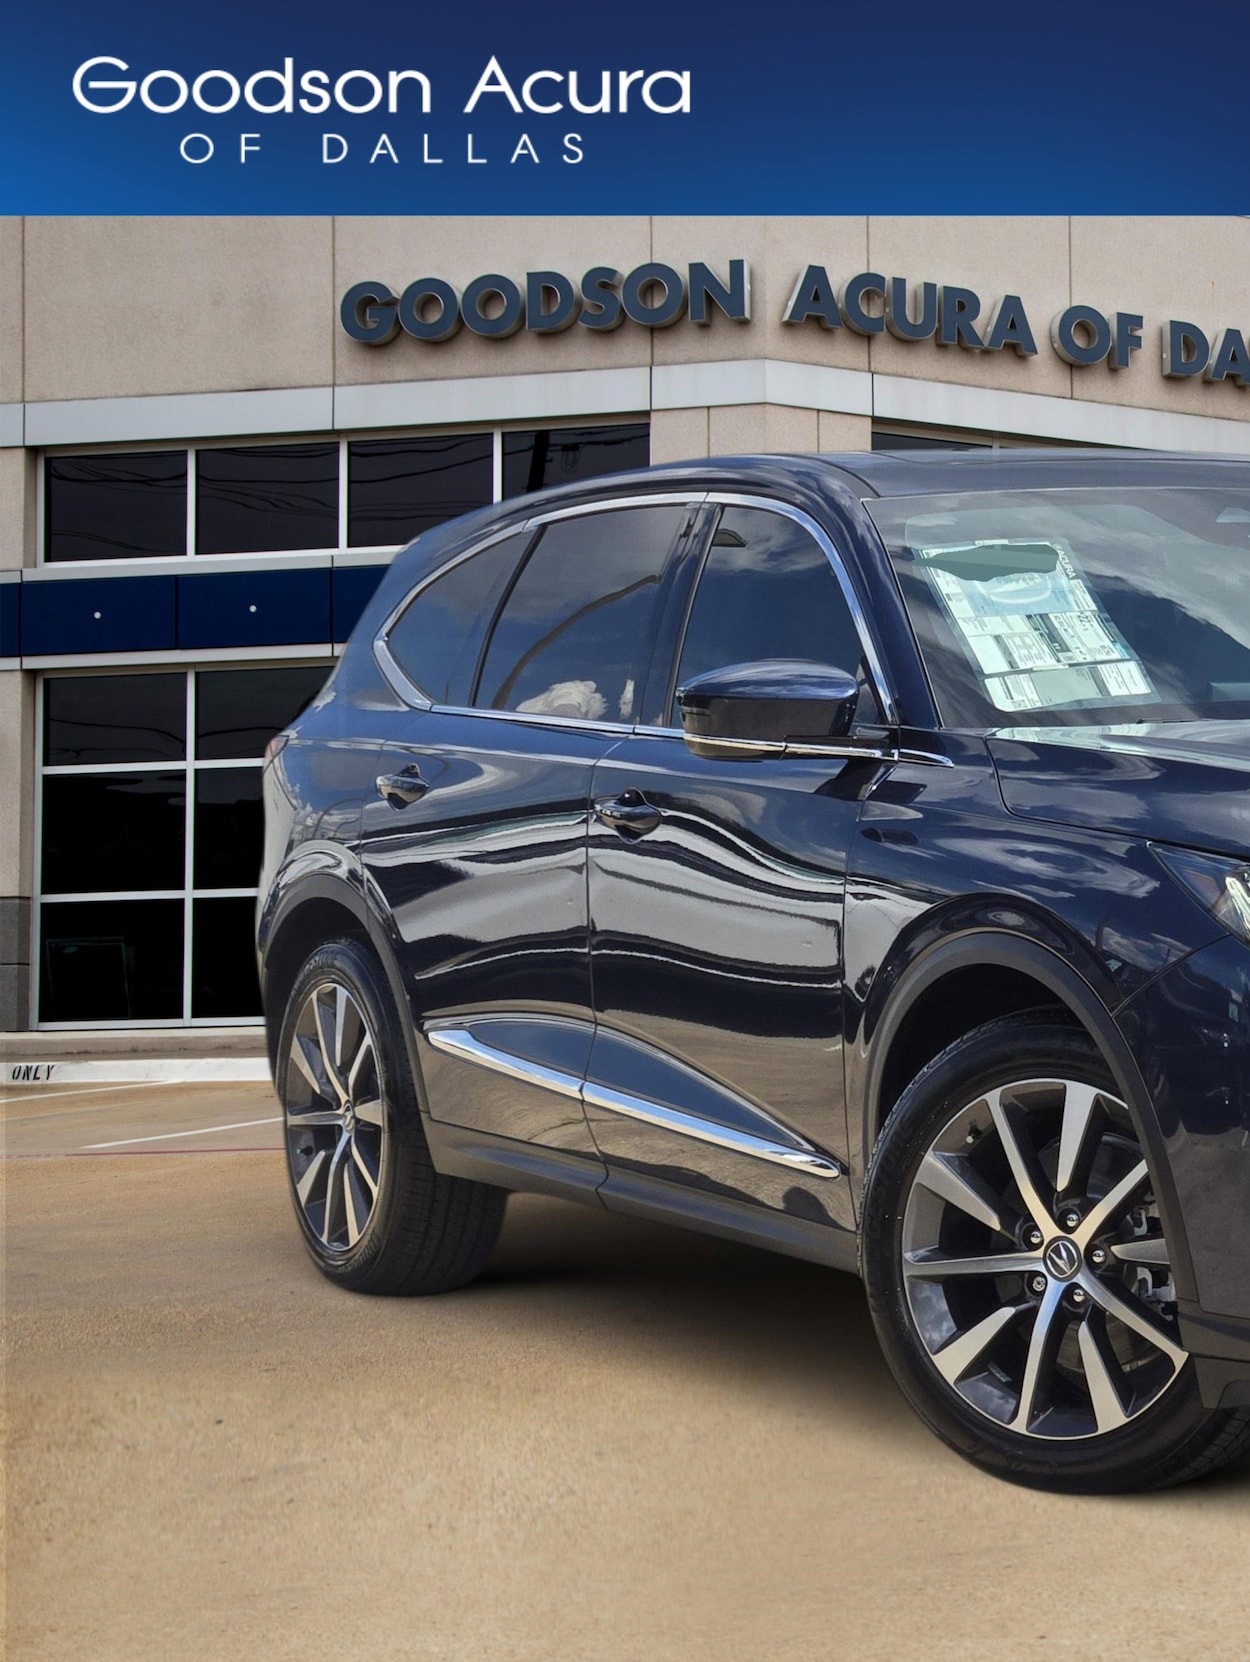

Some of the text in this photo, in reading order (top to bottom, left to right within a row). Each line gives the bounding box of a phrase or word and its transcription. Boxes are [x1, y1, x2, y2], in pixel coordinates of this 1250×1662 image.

[340, 259, 751, 346] GOODSON
[782, 265, 1037, 356] ACURA
[1052, 305, 1143, 369] OF
[12, 1064, 55, 1081] ONLY
